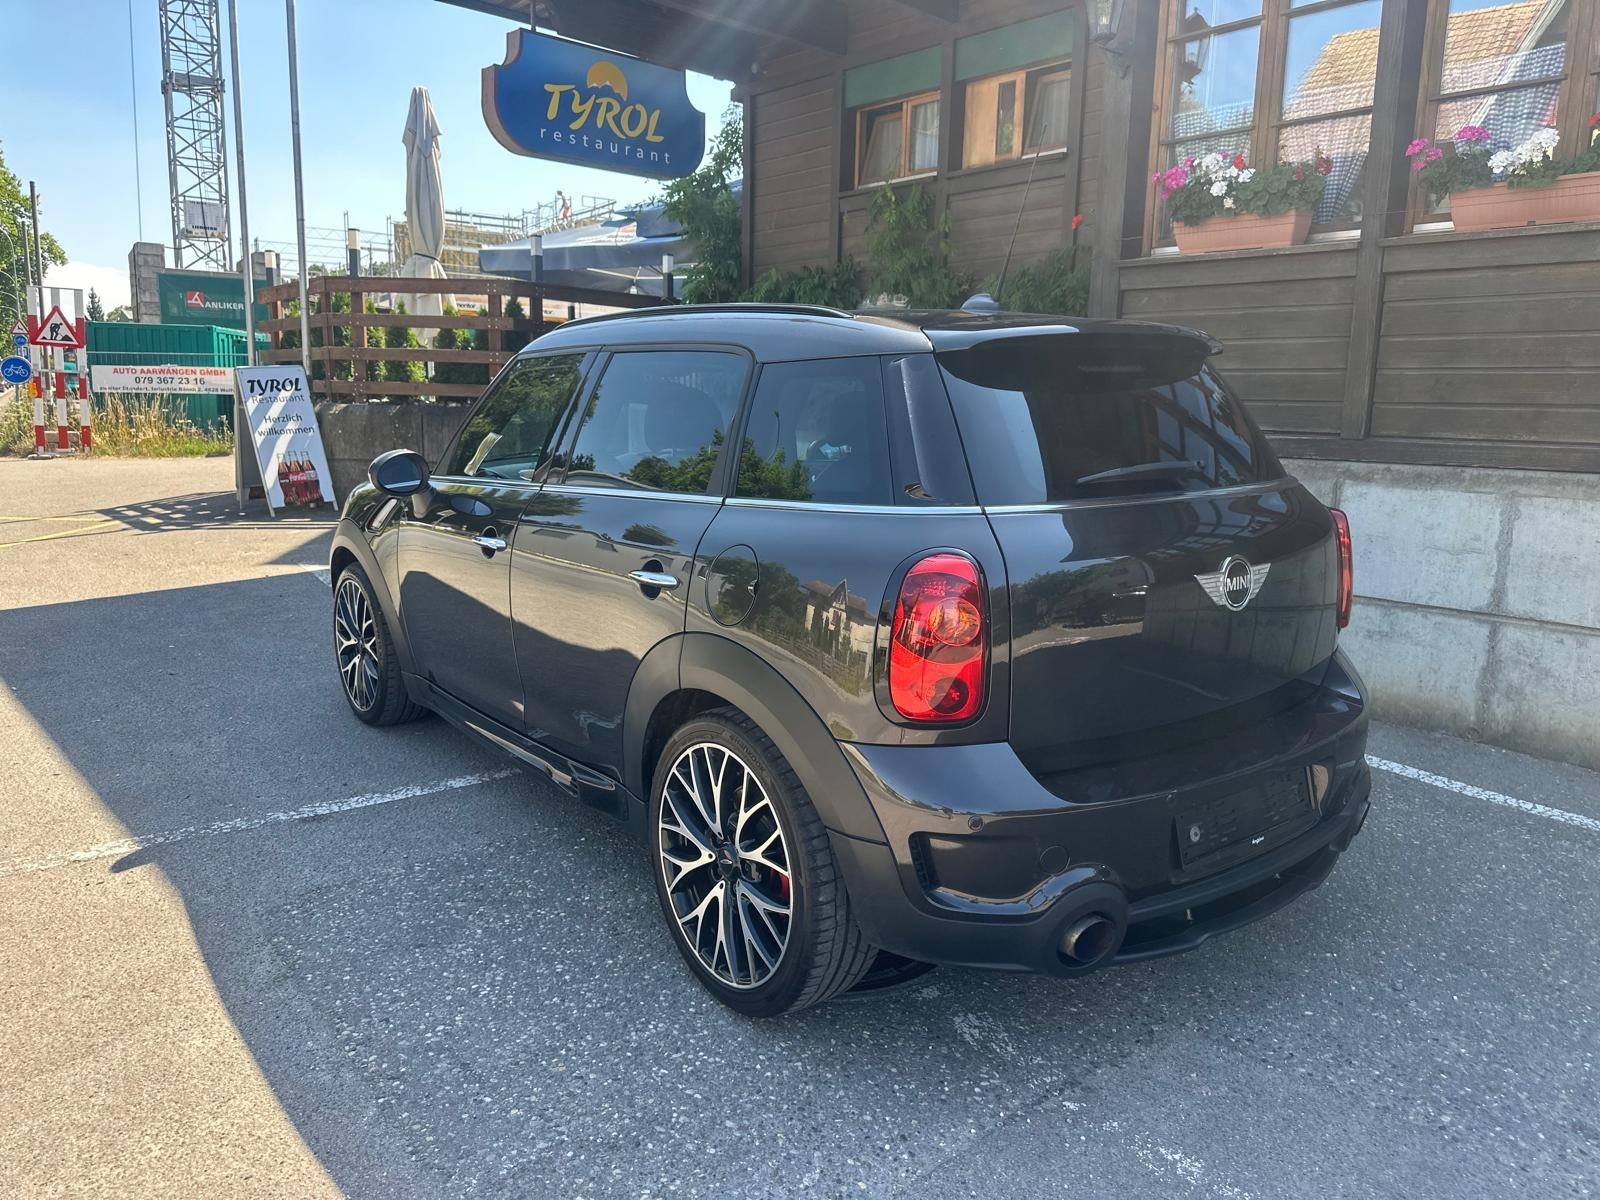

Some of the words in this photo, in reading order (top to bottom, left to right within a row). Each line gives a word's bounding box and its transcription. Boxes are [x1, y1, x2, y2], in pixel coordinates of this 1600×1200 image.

[543, 83, 665, 143] TYROL
[540, 128, 671, 165] restaurant
[205, 301, 244, 310] ANLIKER
[112, 367, 137, 375] AUTO
[140, 367, 199, 376] AARWANGEN
[201, 368, 226, 377] GMBH
[134, 376, 155, 385] 079
[157, 376, 175, 385] 367
[178, 377, 190, 385] 23
[194, 377, 206, 386] 16
[246, 377, 302, 396] TYROL
[252, 394, 305, 404] Restaurant
[263, 413, 303, 424] Herzlich
[257, 425, 315, 437] willkommen
